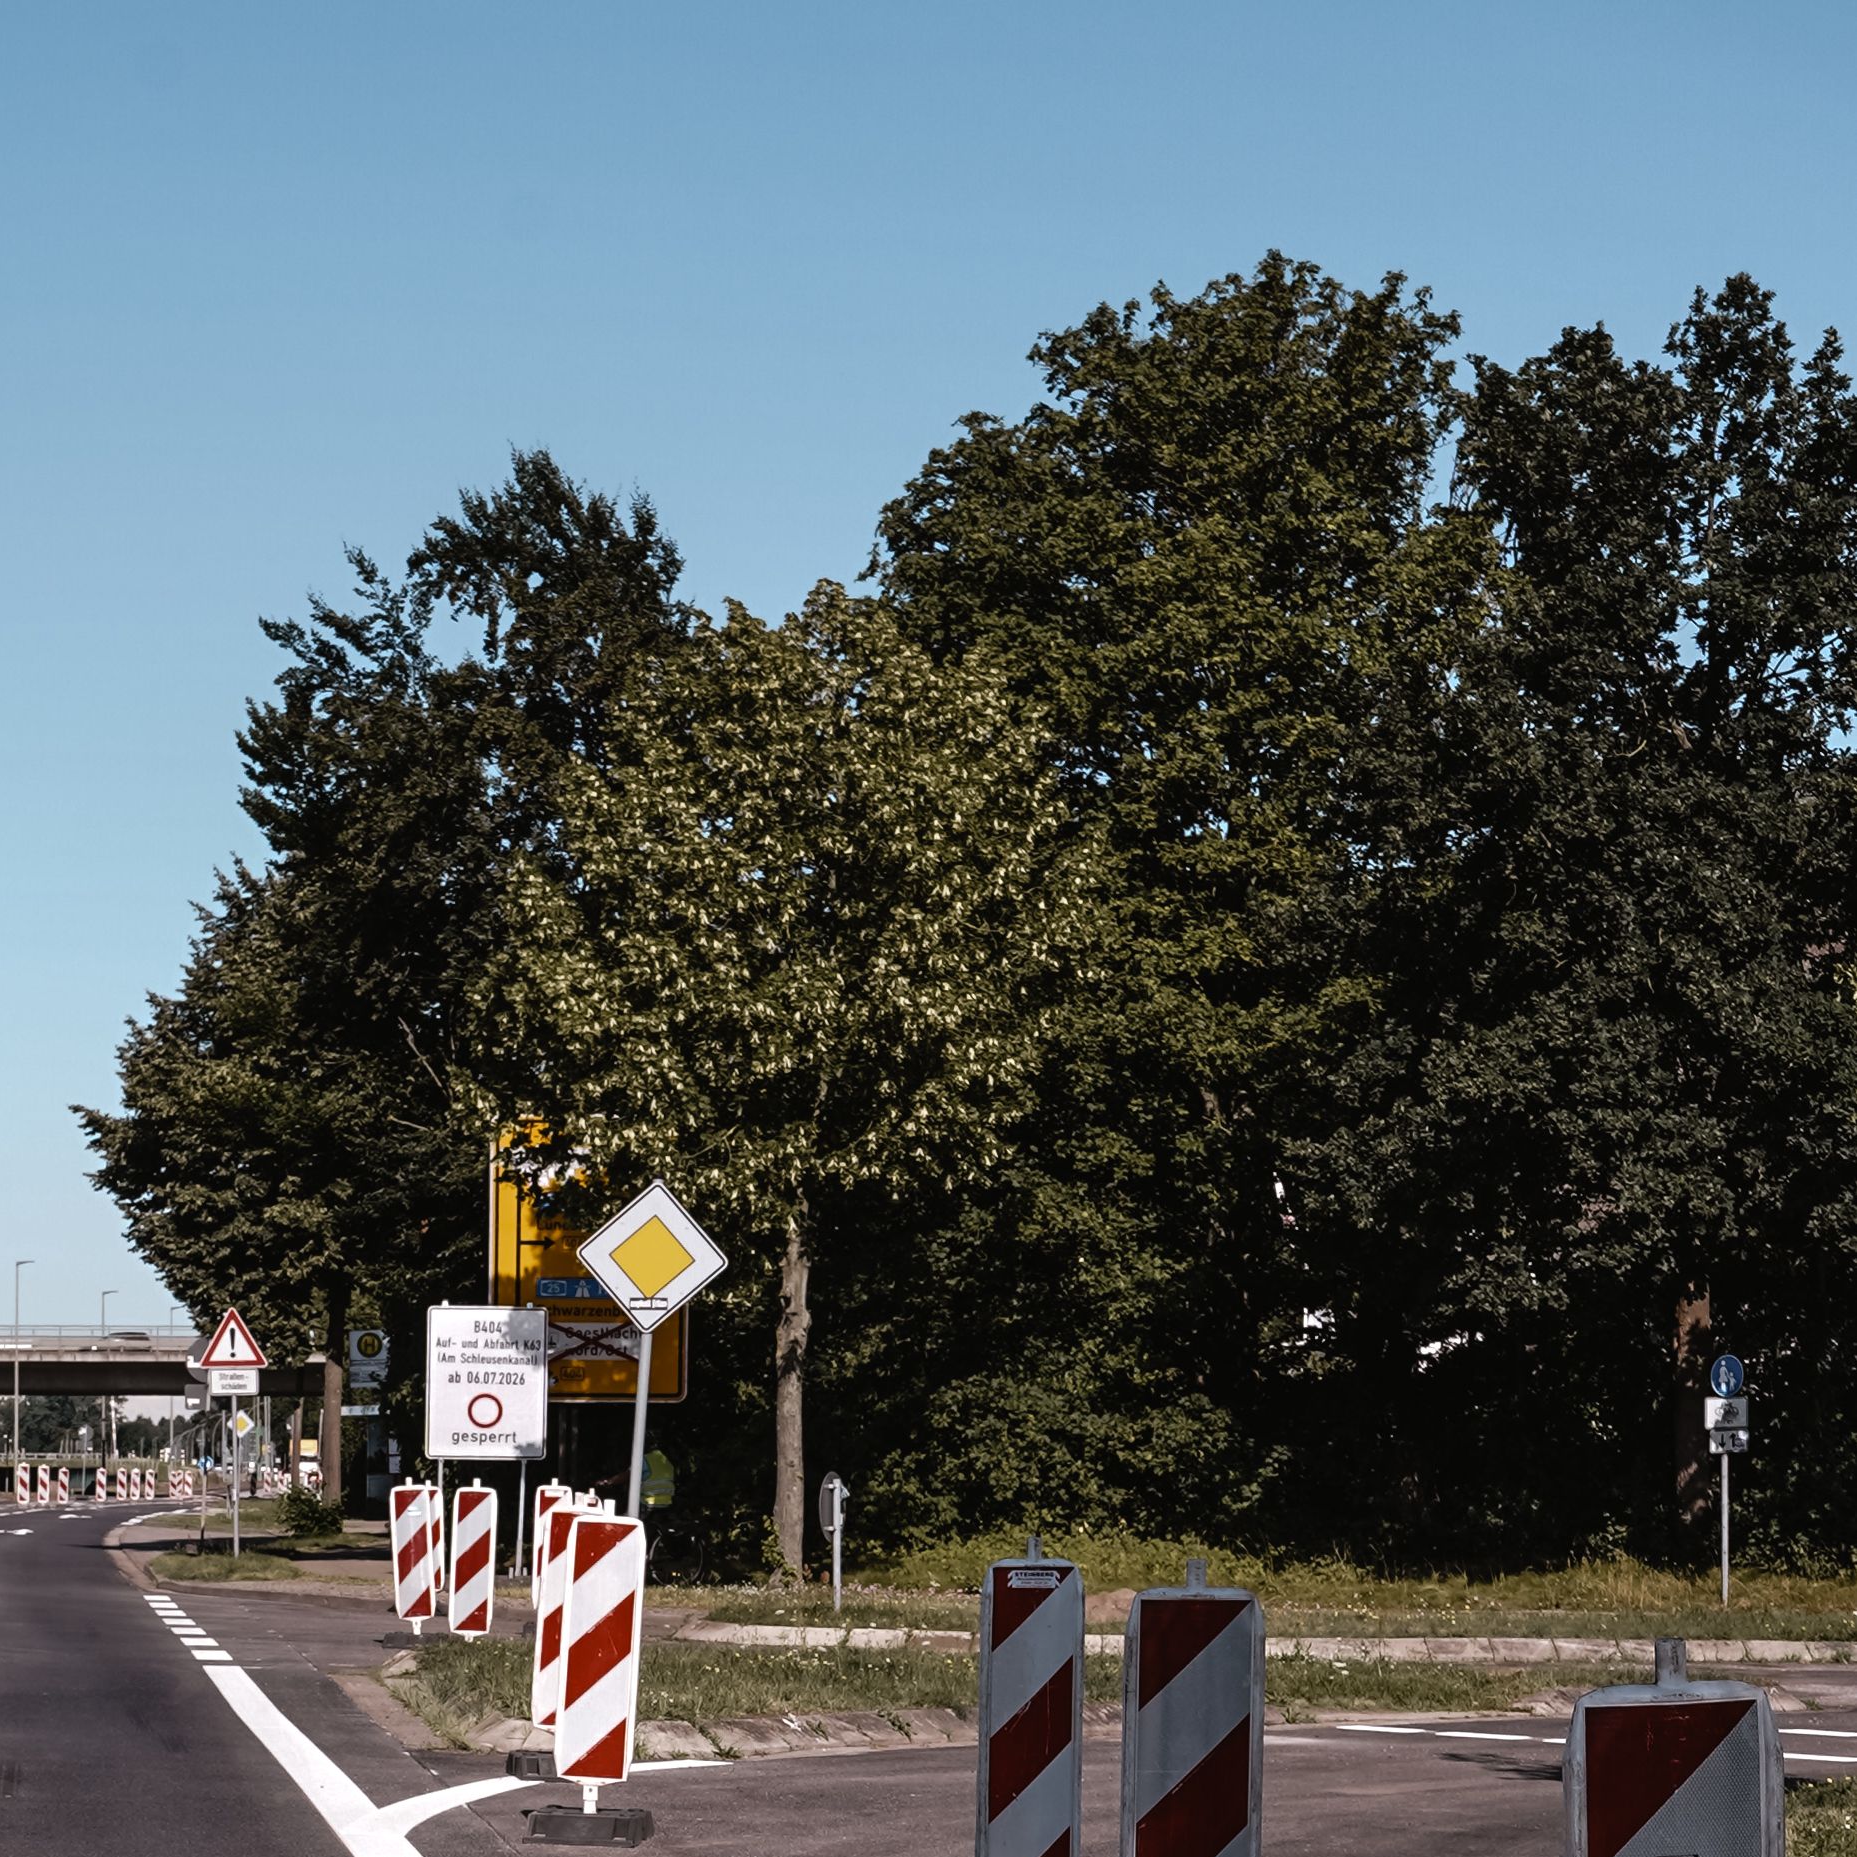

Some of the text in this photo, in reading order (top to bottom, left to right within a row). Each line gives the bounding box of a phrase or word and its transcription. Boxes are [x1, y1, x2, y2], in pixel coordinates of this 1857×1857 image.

[547, 1283, 560, 1293] 25
[474, 1321, 503, 1334] B404
[436, 1338, 541, 1351] Auf- und Abfahrt K63
[437, 1352, 539, 1367] (Am Schleusenkanal)
[448, 1371, 526, 1386] ab 06.07.2026
[451, 1431, 517, 1446] gesperrt
